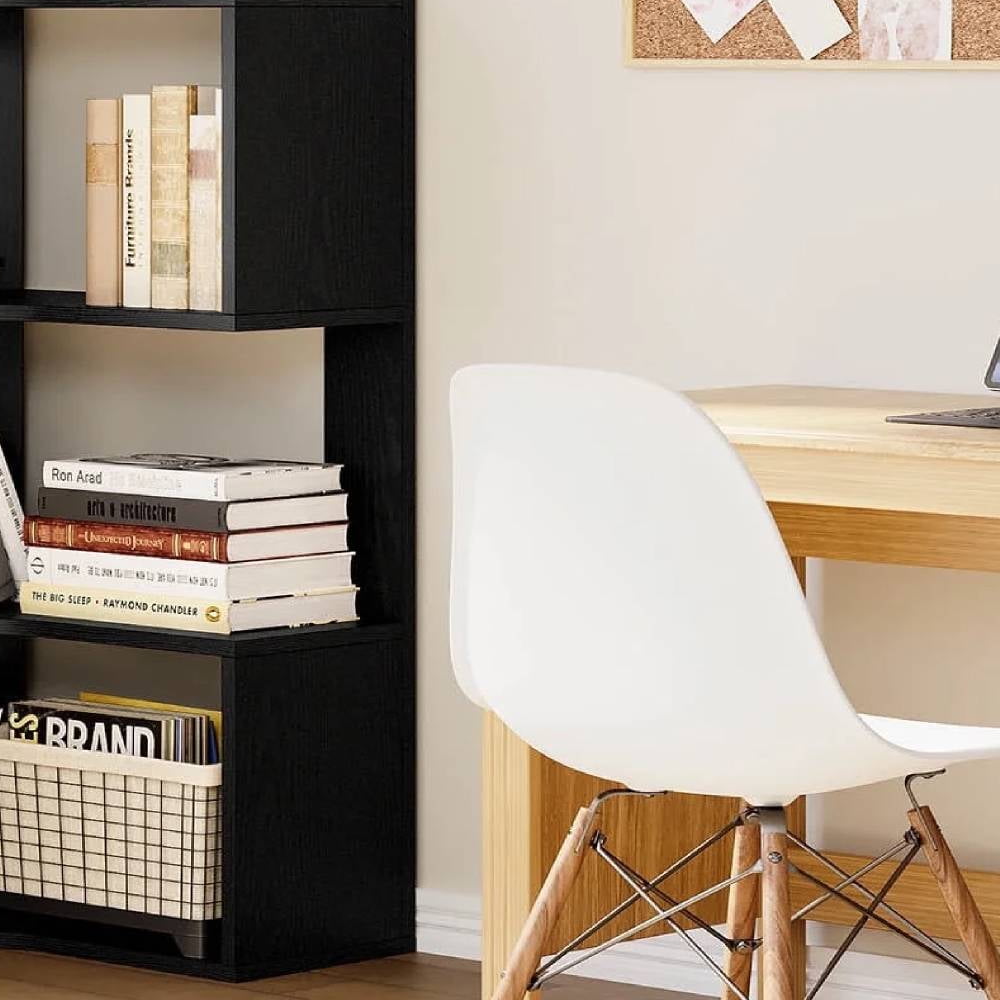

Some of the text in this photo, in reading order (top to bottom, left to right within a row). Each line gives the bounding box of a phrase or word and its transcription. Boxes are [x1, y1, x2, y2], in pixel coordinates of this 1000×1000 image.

[125, 192, 136, 268] Furniture
[51, 468, 73, 482] Ron
[76, 470, 102, 484] Arad
[31, 591, 199, 616] THE BIG SLEEP RAYMOND CHANDLER
[45, 716, 156, 758] BRAND
